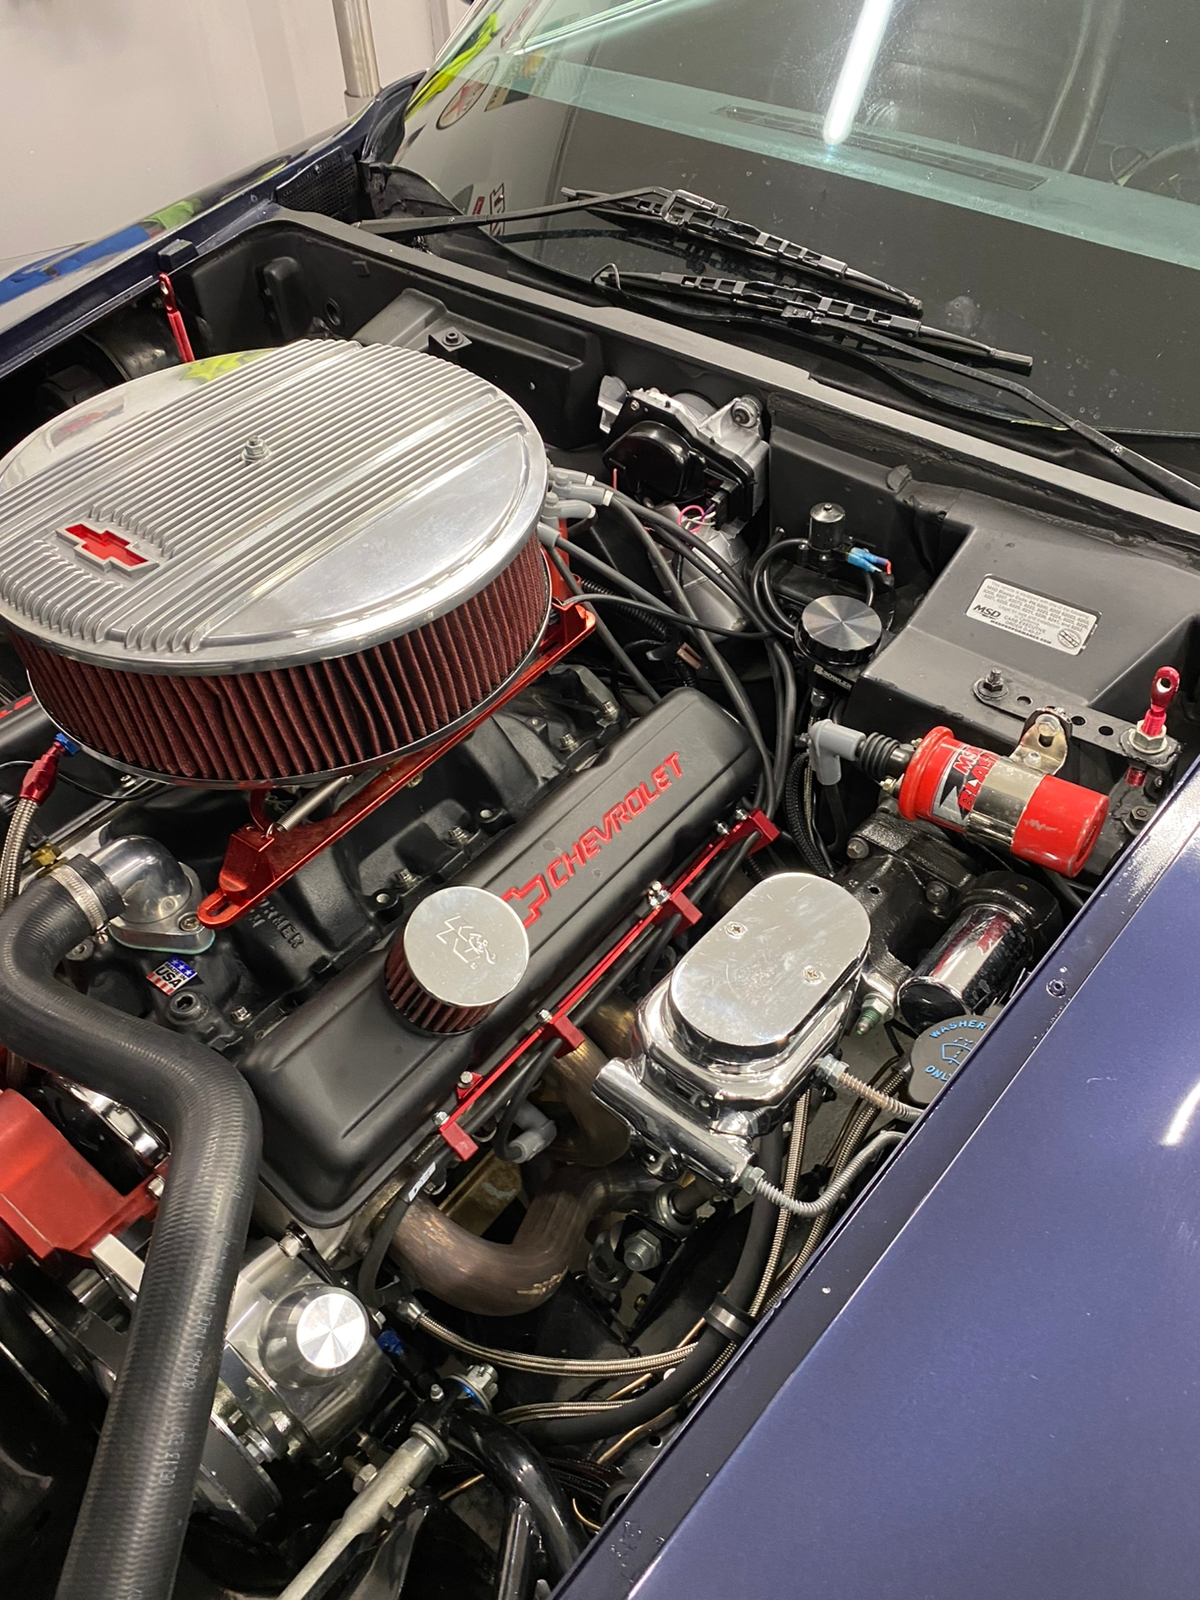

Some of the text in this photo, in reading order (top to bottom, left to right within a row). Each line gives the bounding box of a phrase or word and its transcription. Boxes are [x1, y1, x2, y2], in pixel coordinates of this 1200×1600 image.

[973, 603, 1001, 618] MSD
[545, 751, 683, 889] CHEVROLET
[155, 966, 182, 988] USA
[929, 1019, 988, 1038] WASHER
